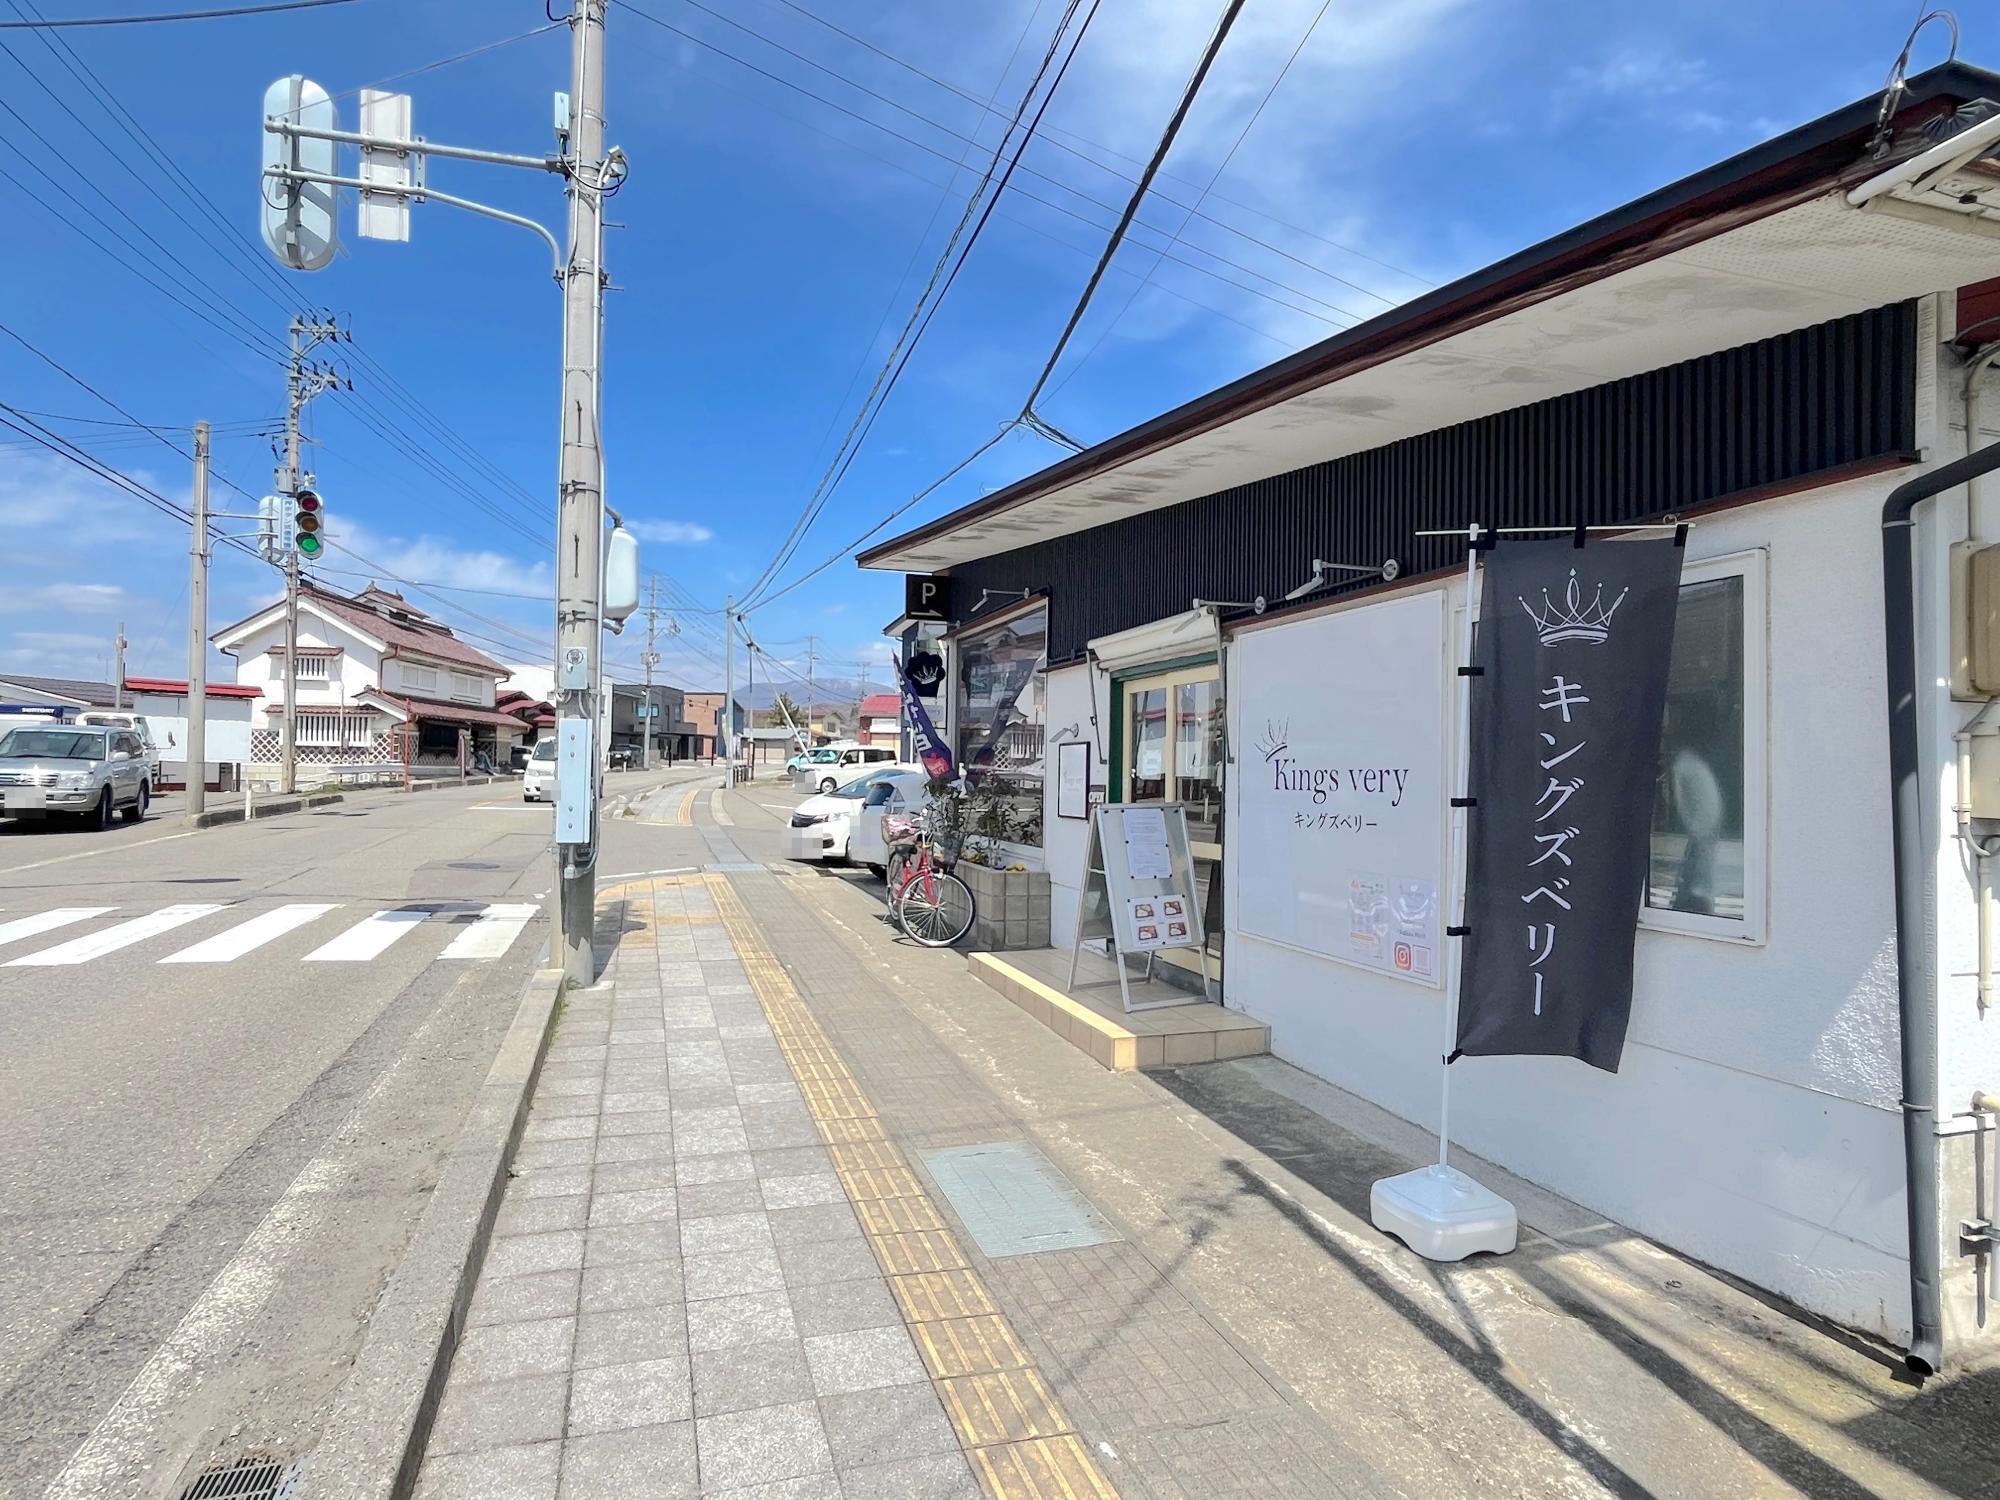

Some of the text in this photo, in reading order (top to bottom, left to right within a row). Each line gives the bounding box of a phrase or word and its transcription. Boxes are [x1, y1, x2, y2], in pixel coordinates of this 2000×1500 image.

[922, 582, 936, 605] P
[1273, 758, 1409, 807] Kings very
[1294, 811, 1378, 833] キングズベリー
[1521, 675, 1590, 1016] キングズベリー
